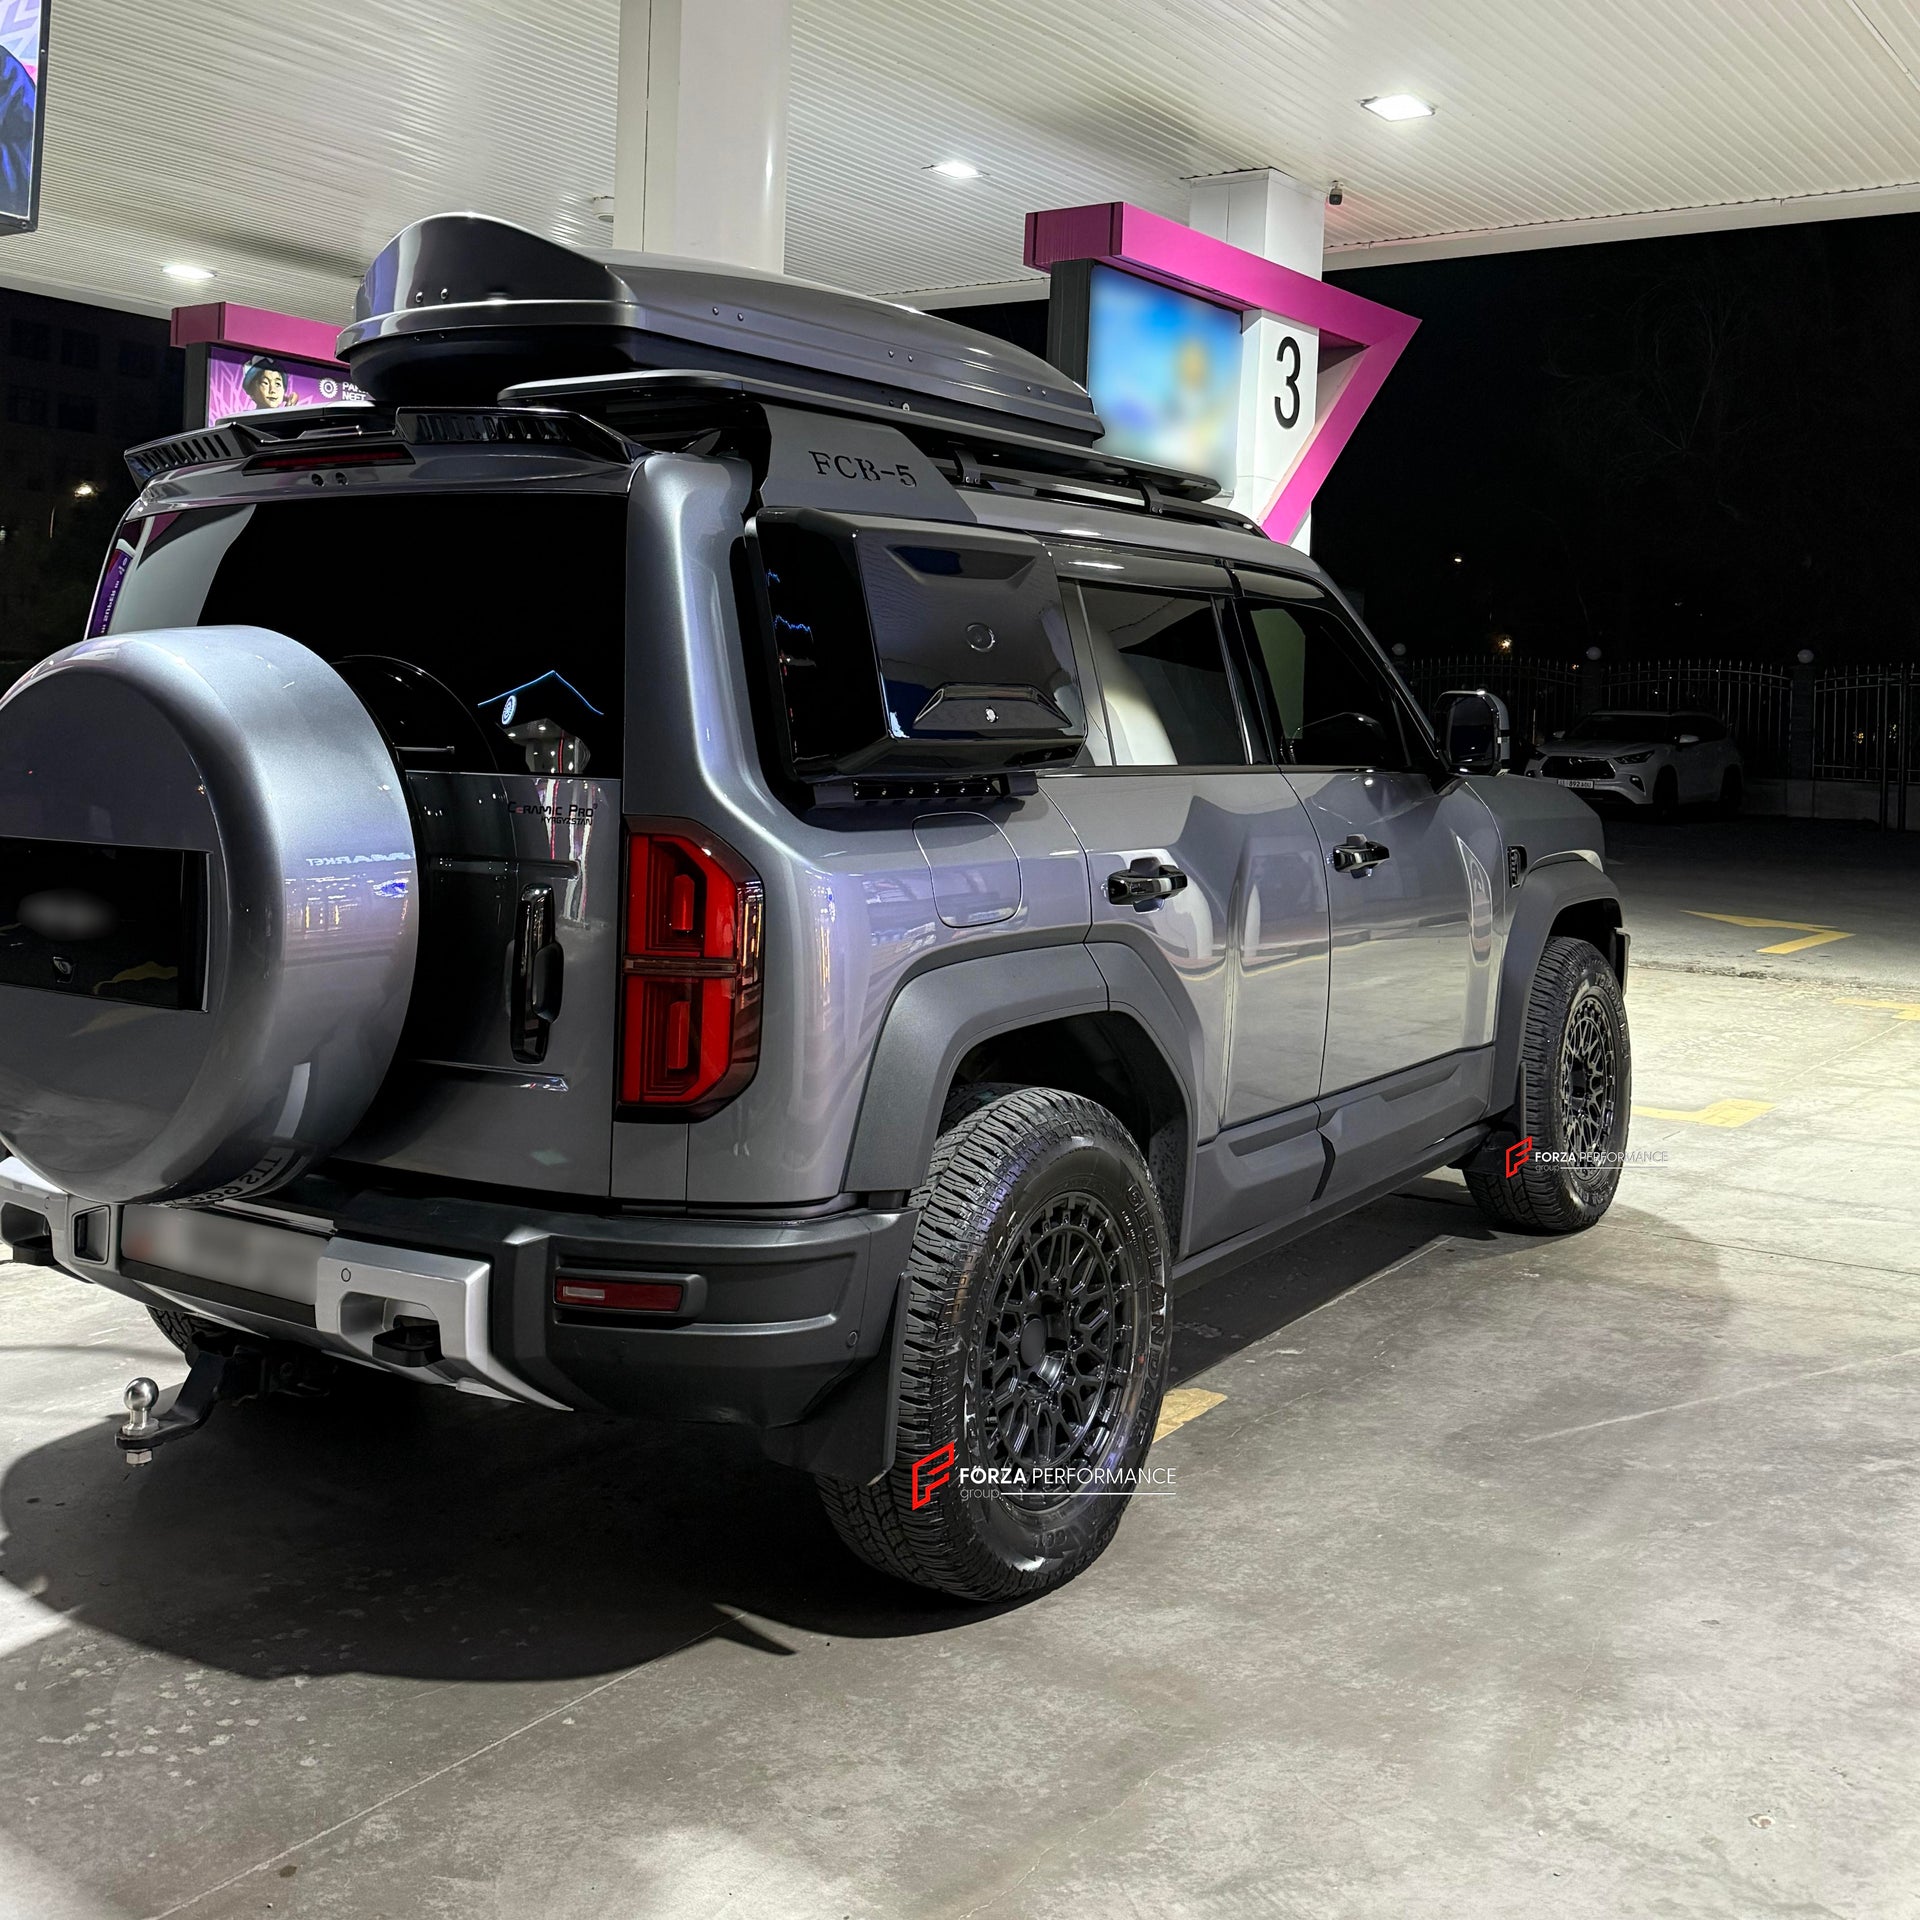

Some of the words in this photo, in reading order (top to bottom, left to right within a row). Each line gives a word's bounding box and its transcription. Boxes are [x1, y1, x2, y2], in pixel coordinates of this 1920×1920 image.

[1274, 336, 1301, 429] 3
[808, 450, 917, 487] FCB-5
[541, 816, 593, 825] KYRGYZSTAN
